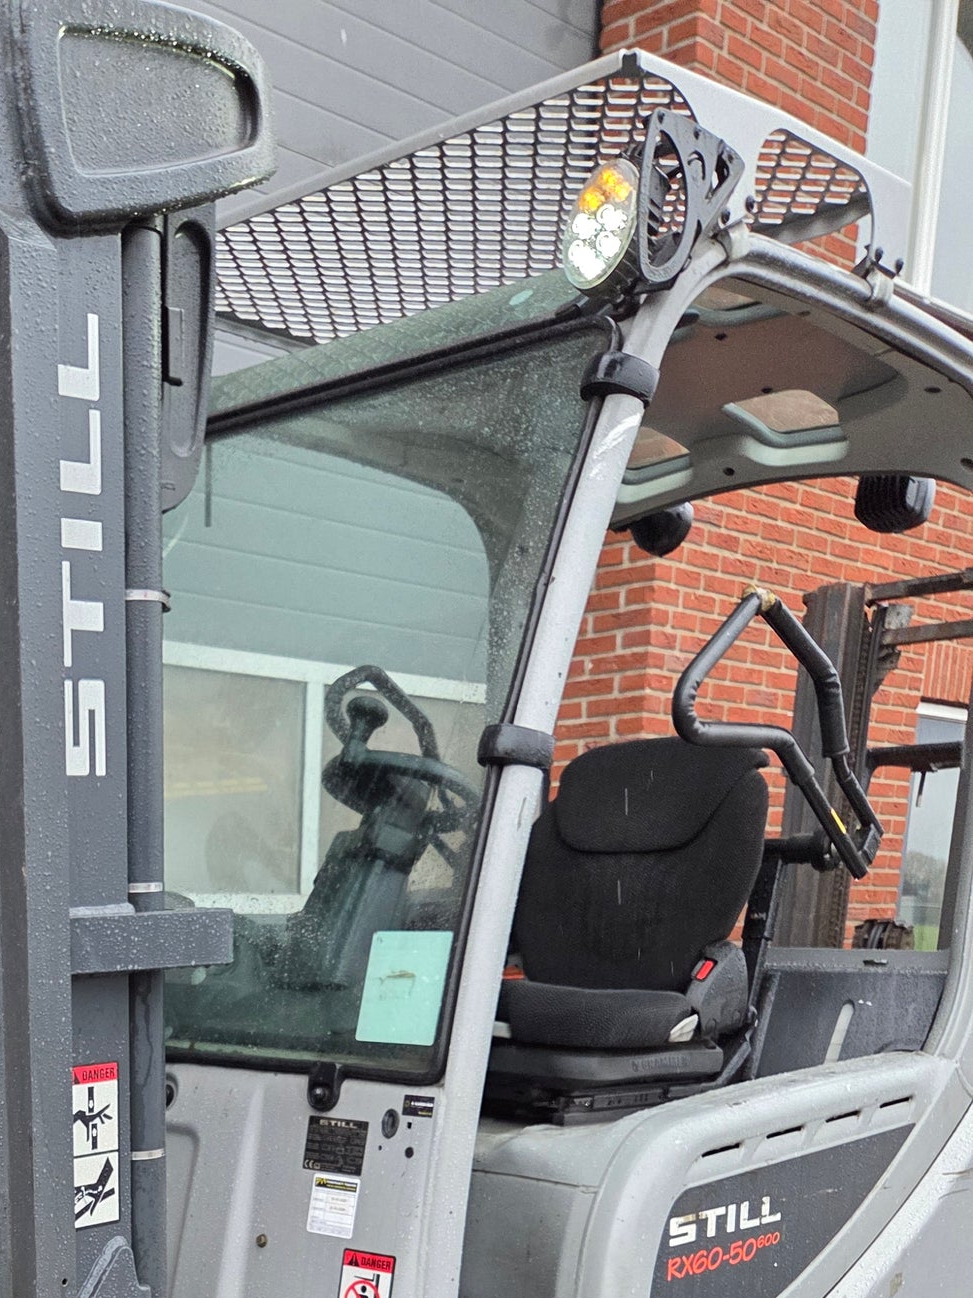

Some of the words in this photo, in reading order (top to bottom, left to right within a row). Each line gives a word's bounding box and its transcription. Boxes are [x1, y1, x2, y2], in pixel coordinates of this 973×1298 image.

[57, 313, 106, 777] STILL
[82, 1067, 115, 1081] DANGER
[319, 1119, 357, 1129] STILL
[669, 1196, 782, 1247] STILL
[361, 1257, 391, 1271] DANGER
